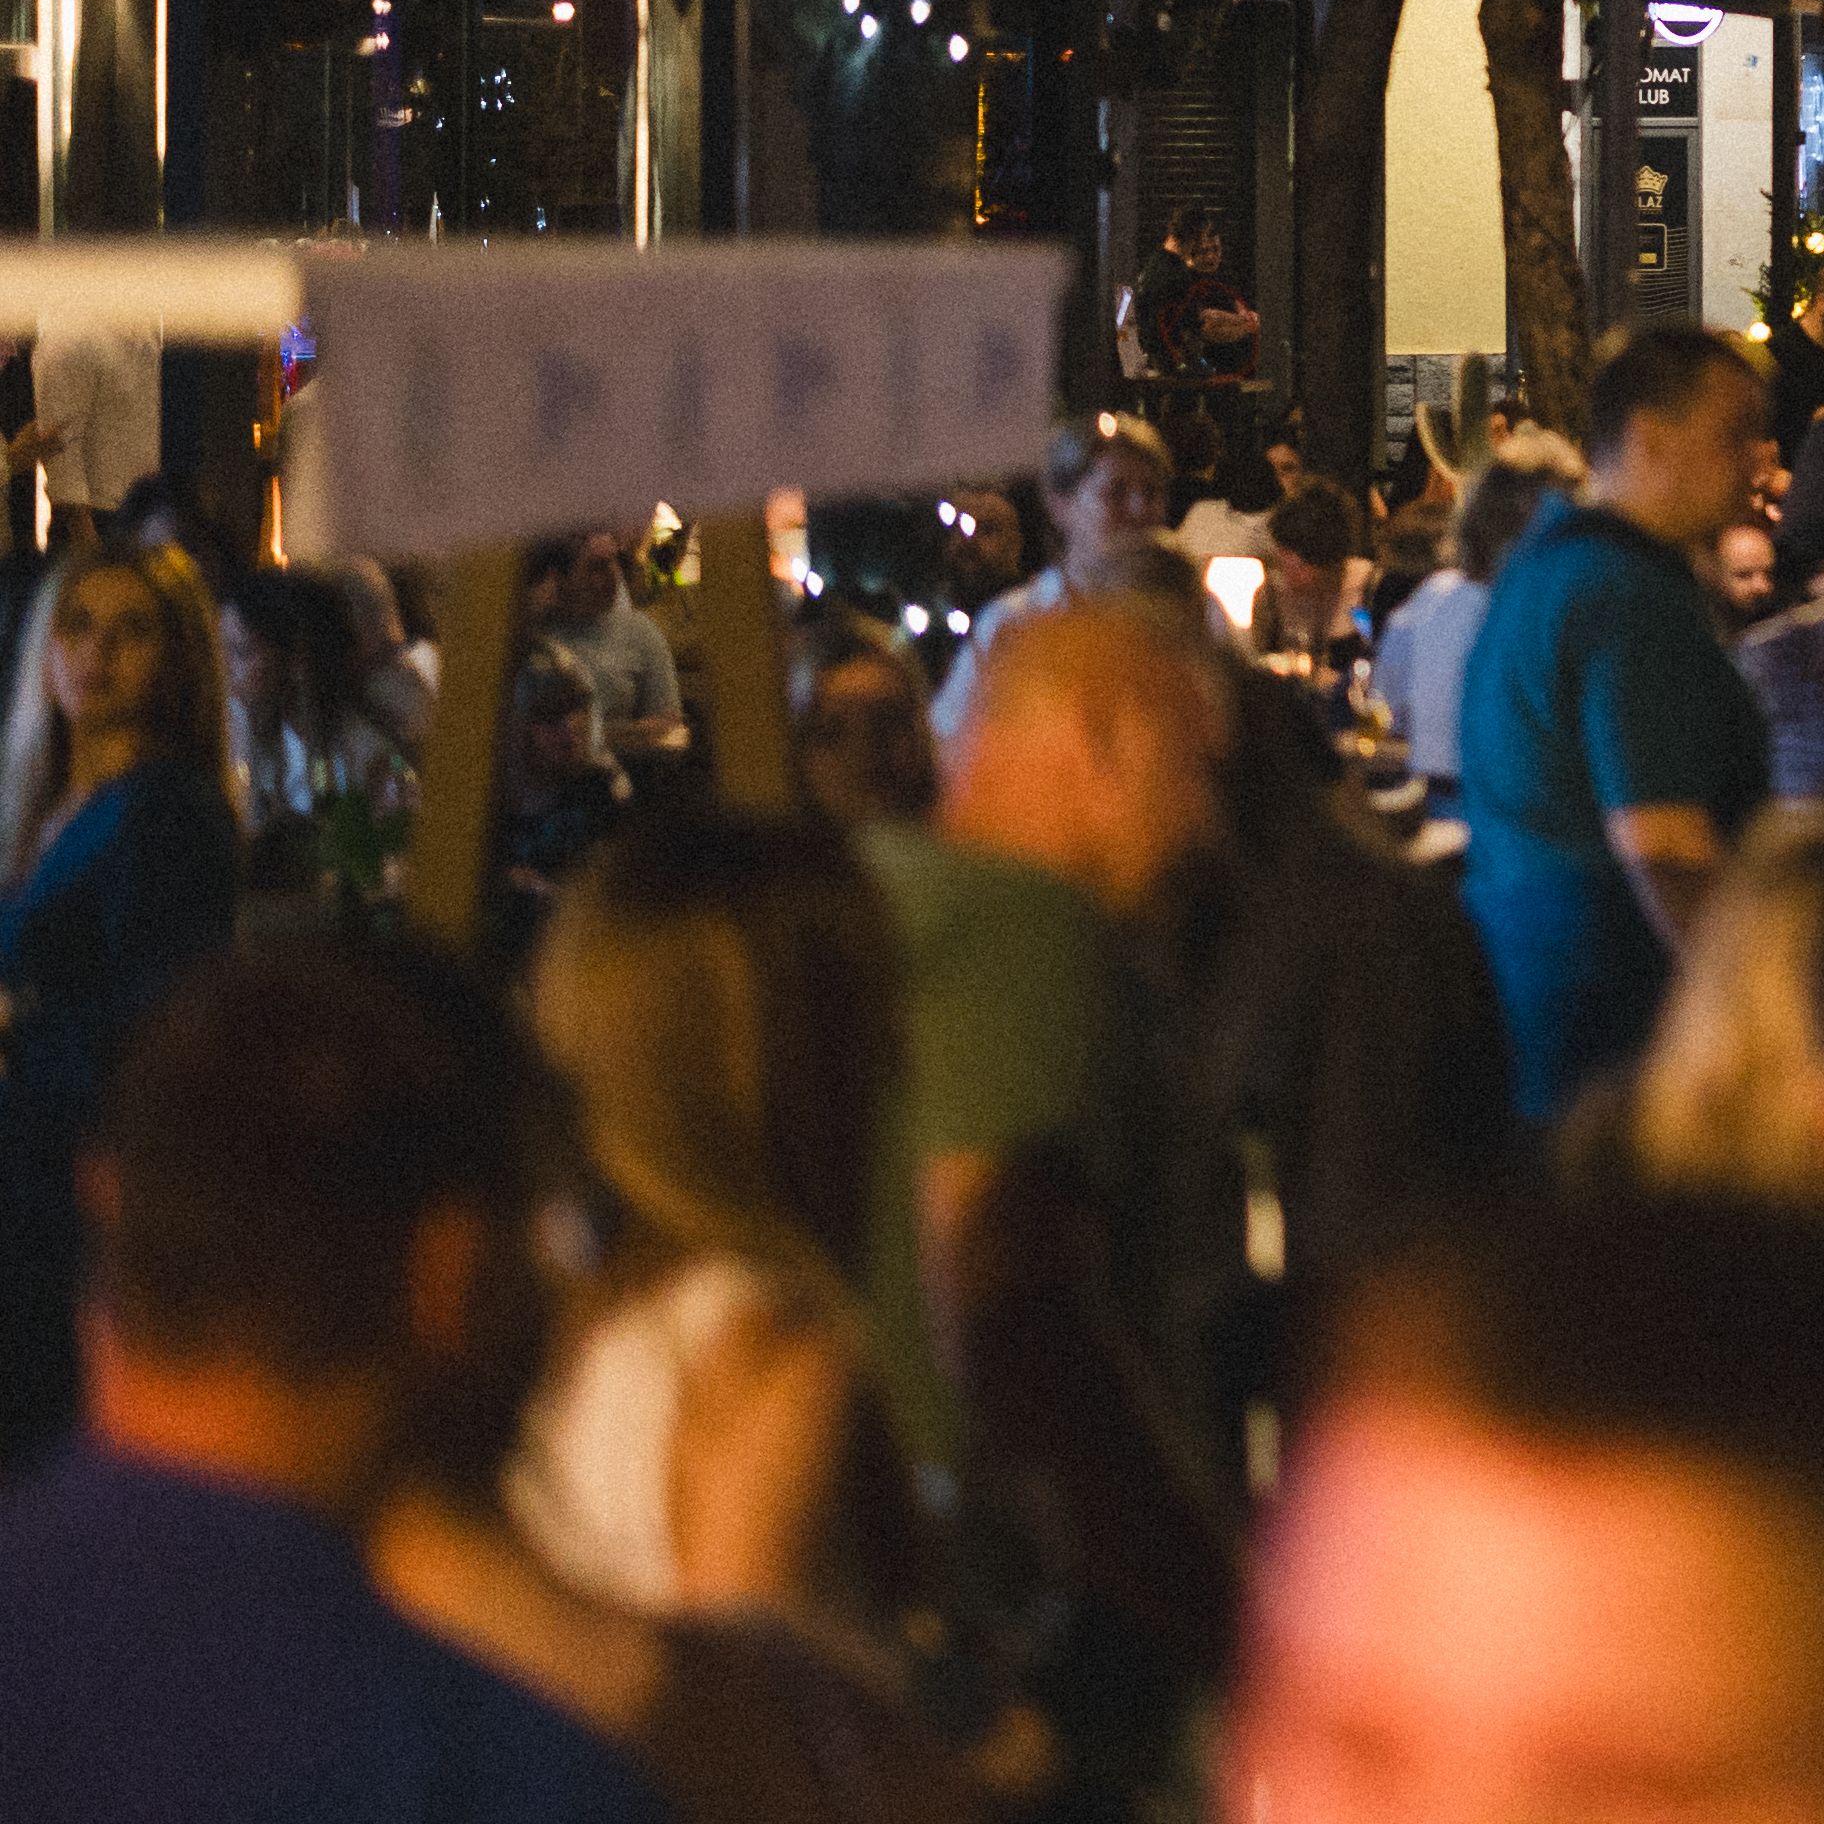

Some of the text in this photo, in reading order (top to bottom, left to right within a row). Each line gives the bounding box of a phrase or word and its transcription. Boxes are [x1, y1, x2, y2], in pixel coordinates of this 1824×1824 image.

[1639, 68, 1691, 83] OMAT
[1638, 89, 1670, 105] LUB
[1637, 196, 1664, 208] LAZ
